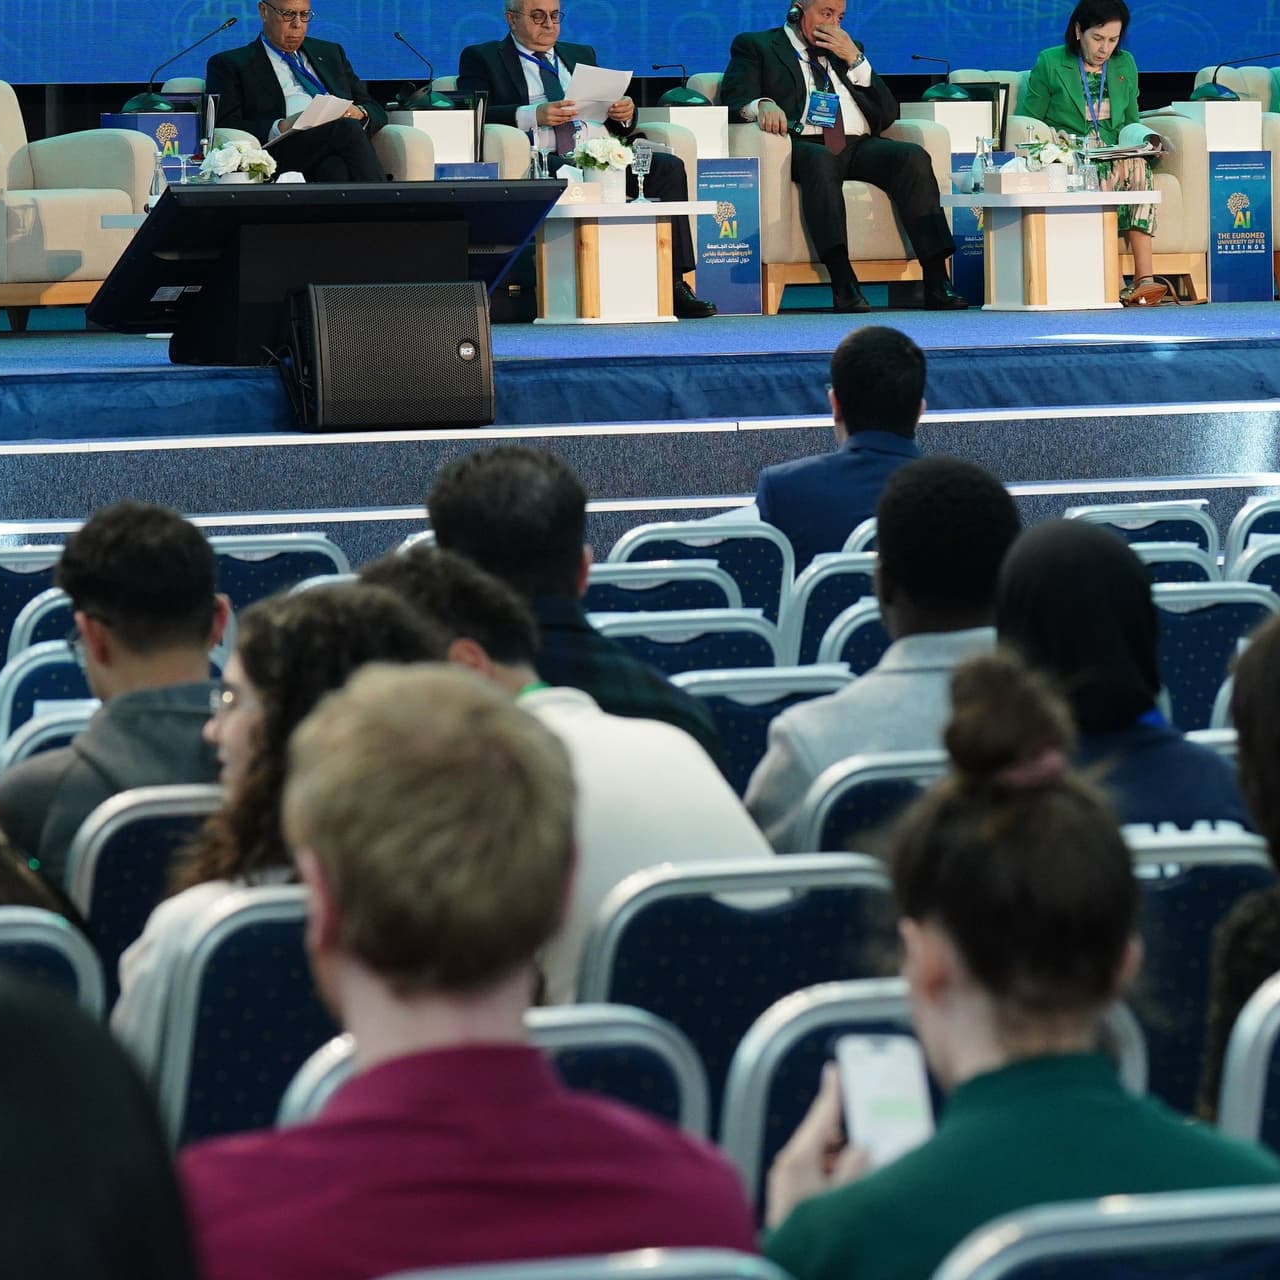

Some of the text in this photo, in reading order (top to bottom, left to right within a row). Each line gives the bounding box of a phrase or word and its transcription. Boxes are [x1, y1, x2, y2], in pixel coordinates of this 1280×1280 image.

[163, 140, 179, 156] AI
[1233, 211, 1251, 229] AI
[719, 220, 737, 239] AI
[1232, 231, 1265, 240] EUROMED
